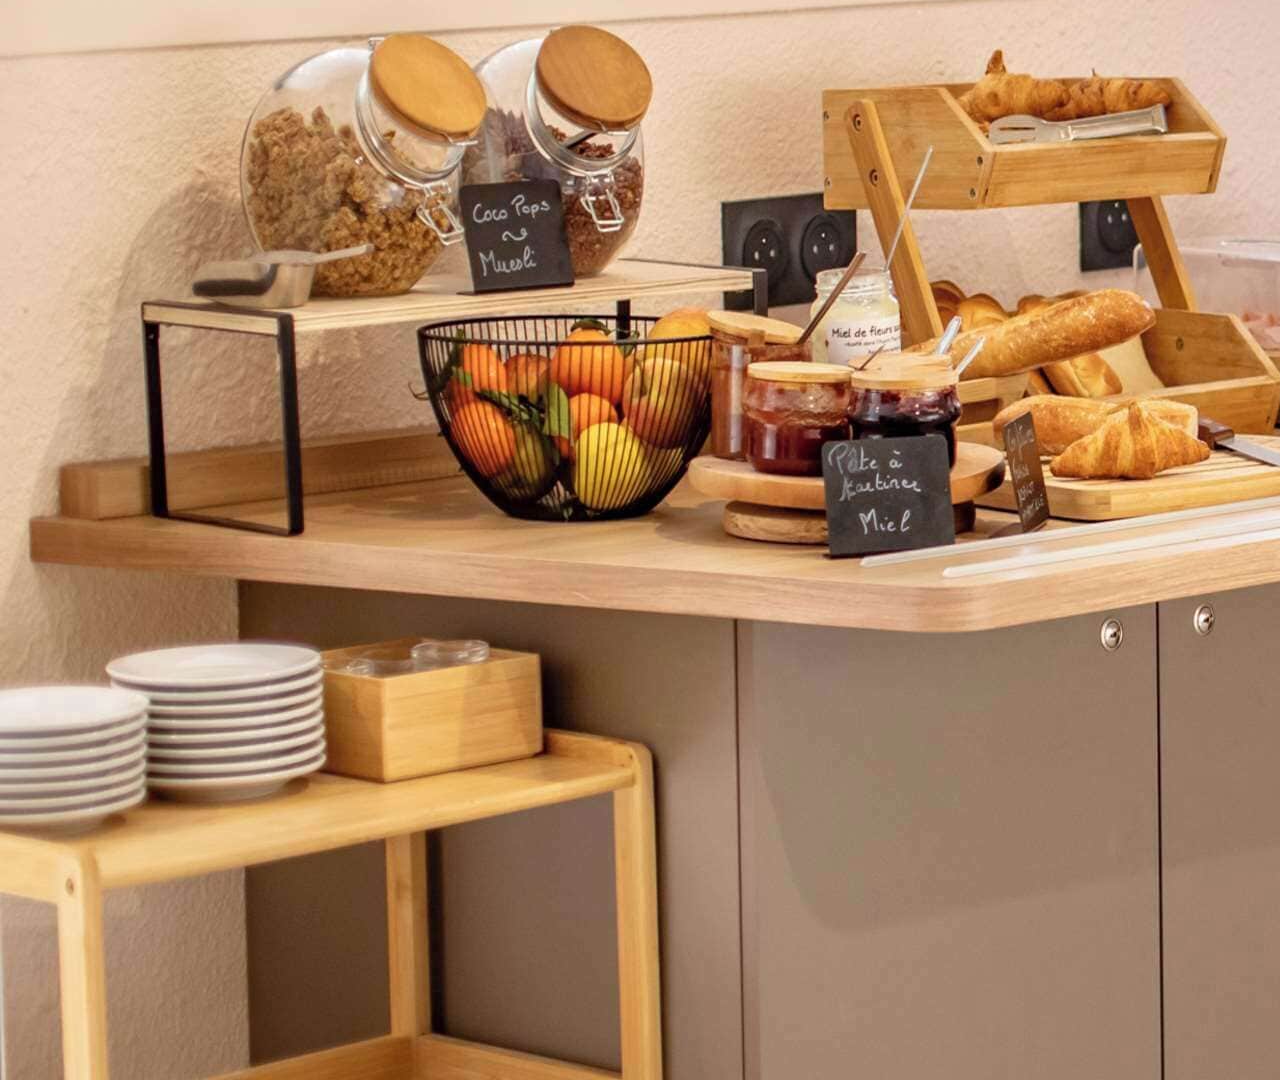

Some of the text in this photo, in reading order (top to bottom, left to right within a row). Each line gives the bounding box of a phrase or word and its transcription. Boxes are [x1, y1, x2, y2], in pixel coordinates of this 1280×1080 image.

[472, 193, 551, 224] Coco Pops
[478, 245, 538, 278] Muesli
[832, 327, 851, 338] Miel
[854, 327, 867, 338] de
[888, 449, 903, 469] à
[858, 507, 911, 535] Miel
